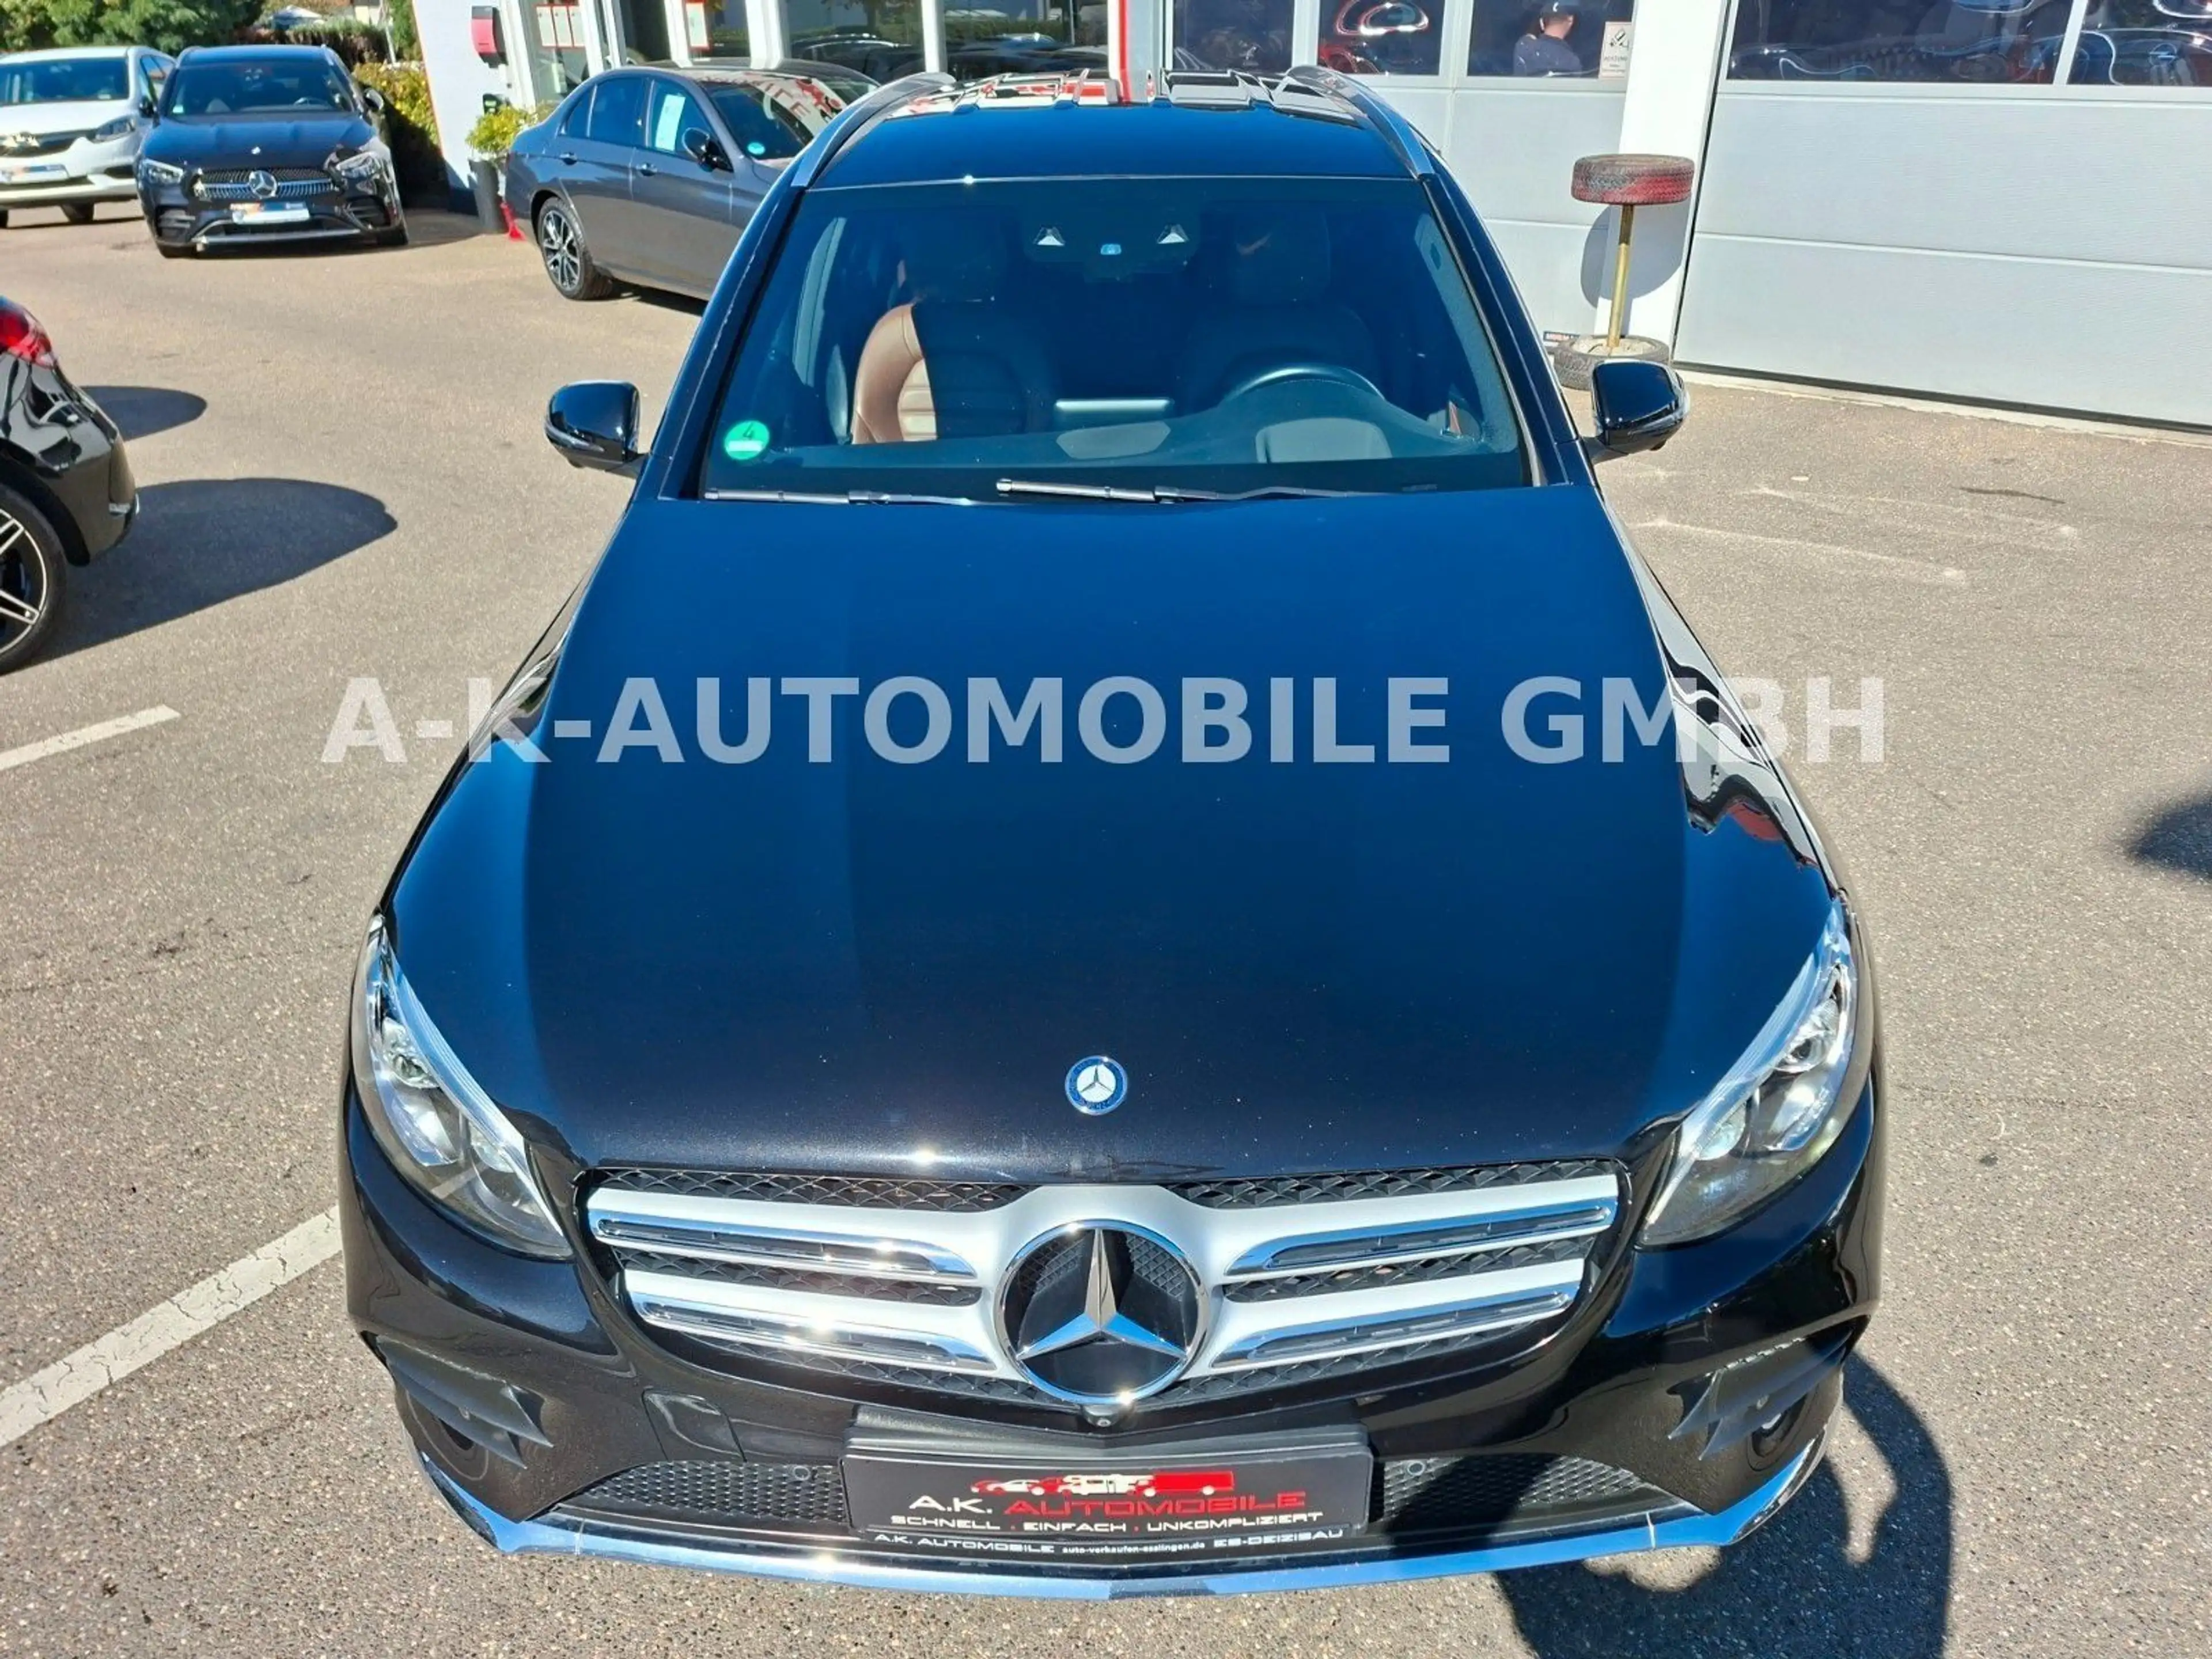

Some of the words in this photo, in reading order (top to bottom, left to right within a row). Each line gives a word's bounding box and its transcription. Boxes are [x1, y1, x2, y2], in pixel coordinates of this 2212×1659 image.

[908, 1495, 993, 1514] A.K.
[1003, 1491, 1306, 1516] AUTOMOBILE
[891, 1515, 1001, 1531] SCHNELL
[1023, 1522, 1127, 1532] EINFACH
[1147, 1512, 1324, 1532] UNKOMPLIZIERT
[874, 1534, 913, 1544] A.K.
[917, 1538, 1055, 1553] AUTOMOBILE
